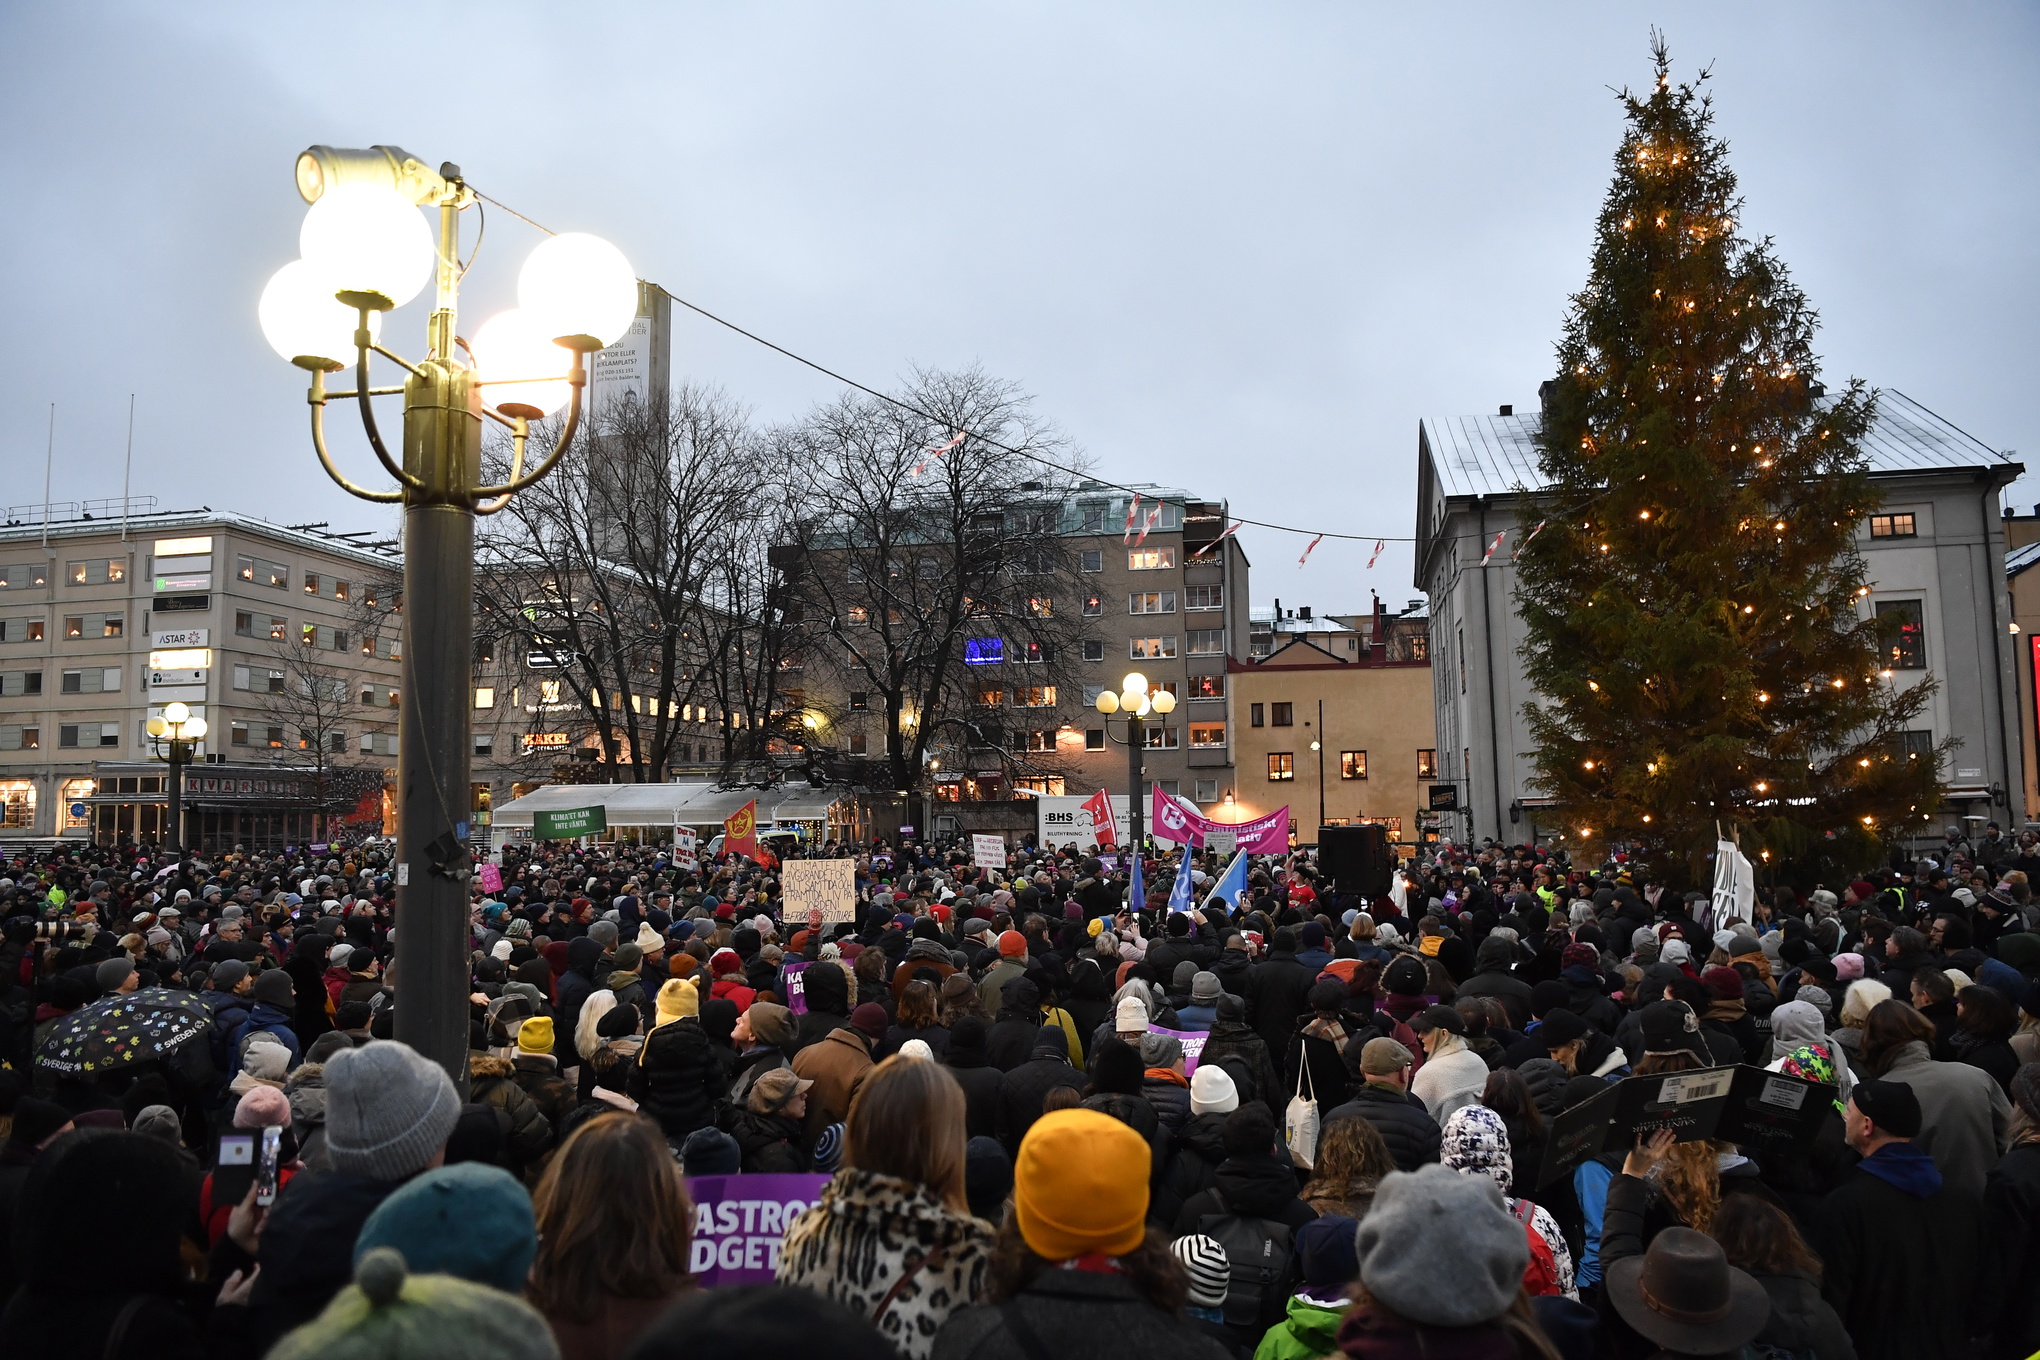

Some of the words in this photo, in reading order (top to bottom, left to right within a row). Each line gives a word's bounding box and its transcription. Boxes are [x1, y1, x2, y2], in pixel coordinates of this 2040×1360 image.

[577, 810, 590, 818] KAN
[555, 822, 569, 830] INTE
[1198, 818, 1277, 834] Feministiskt
[164, 1027, 198, 1049] SWEDEN
[41, 1058, 75, 1072] SVERIGE
